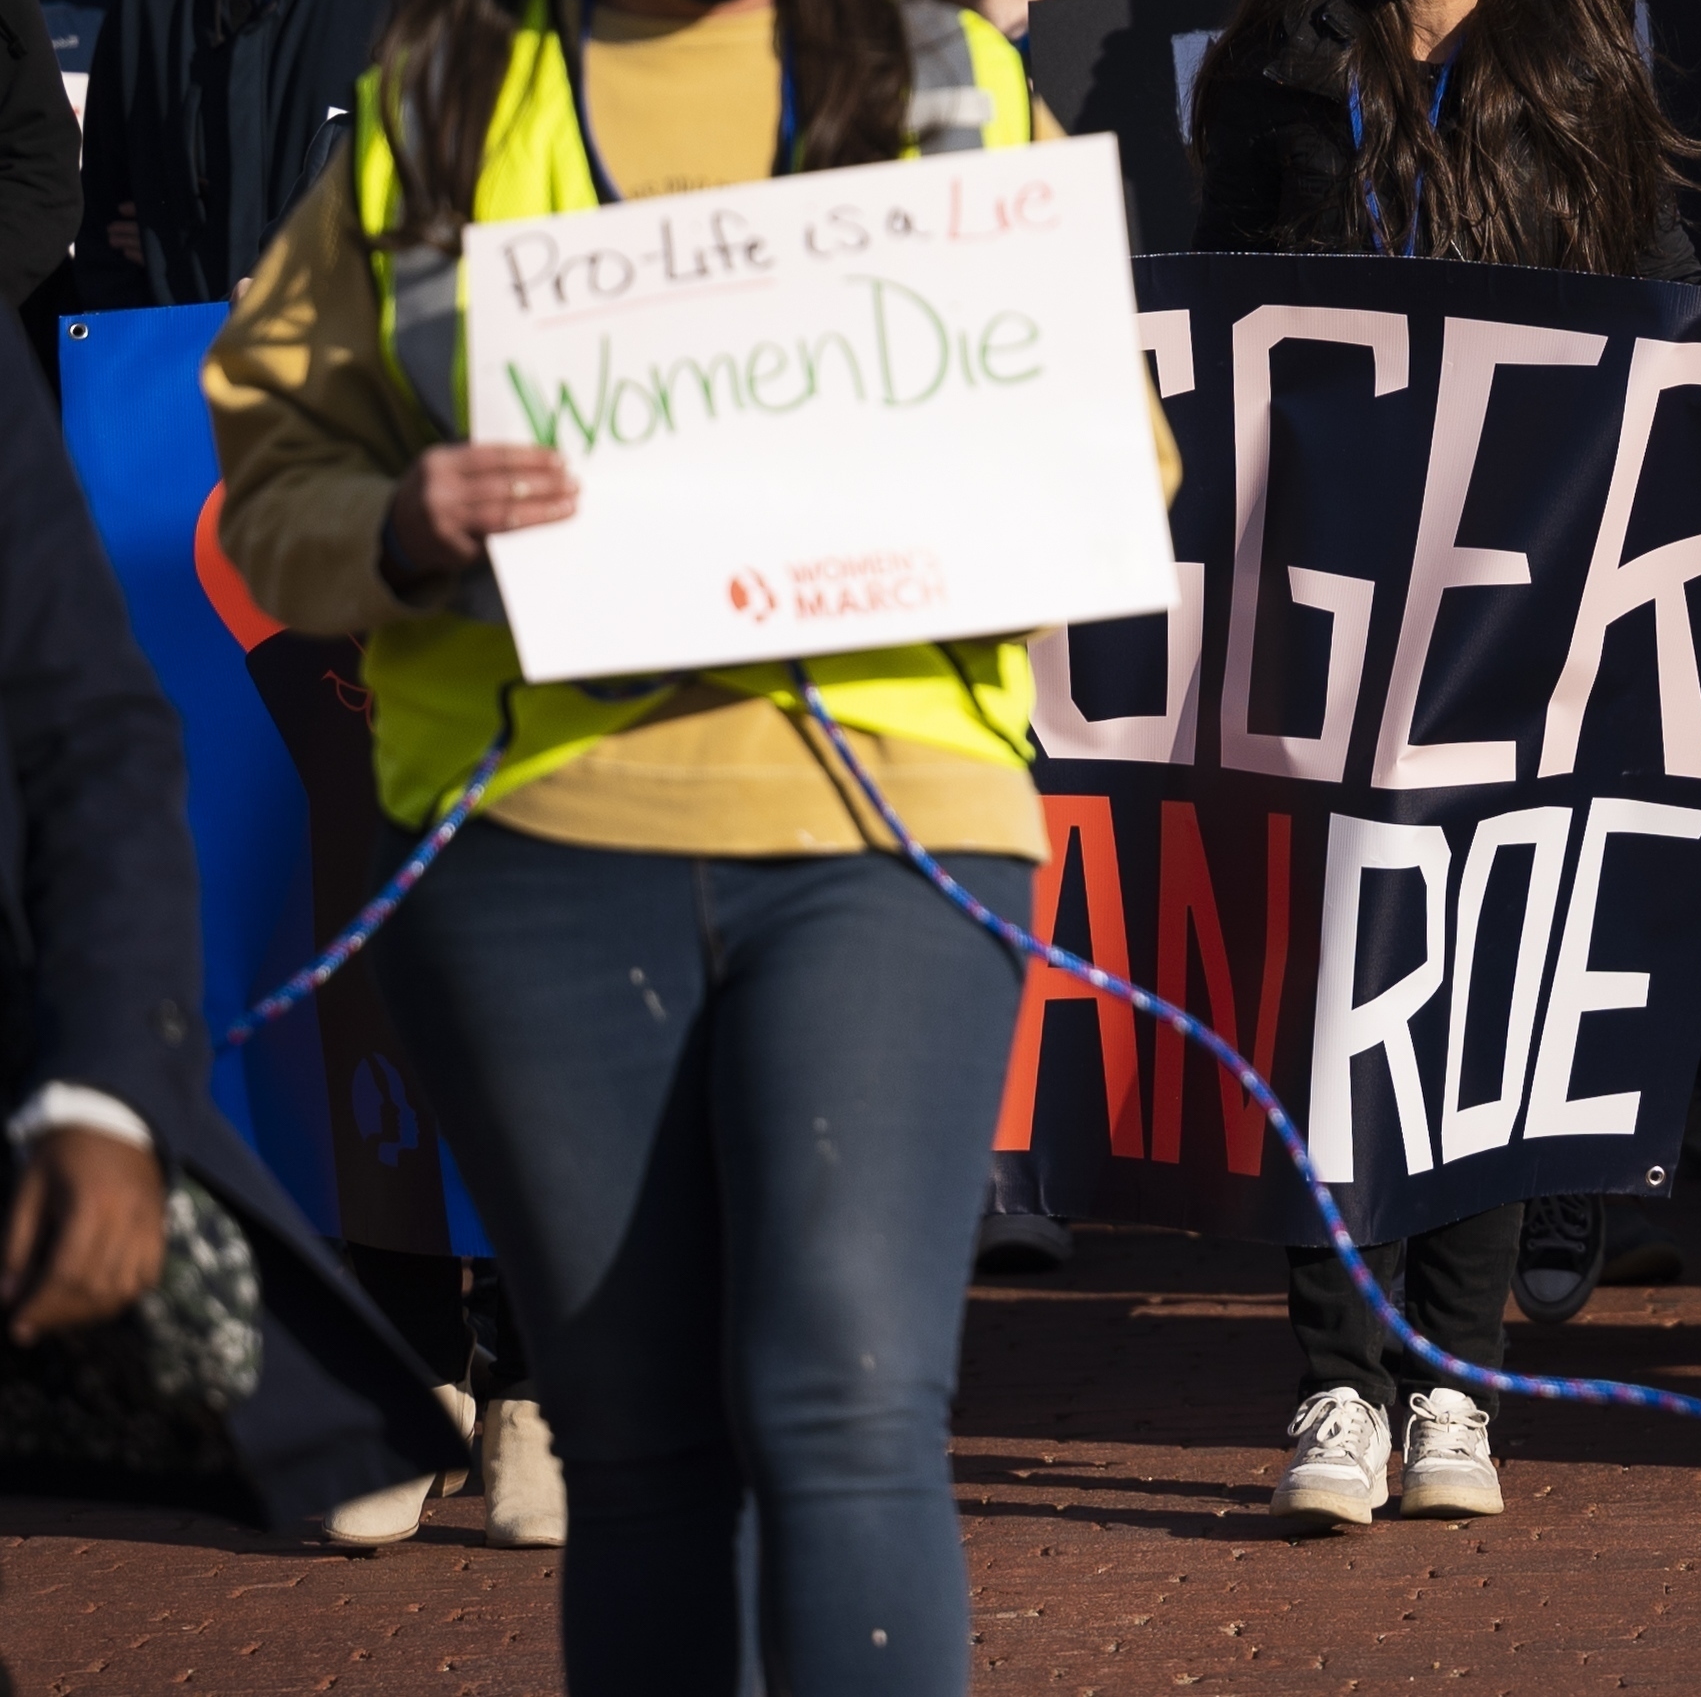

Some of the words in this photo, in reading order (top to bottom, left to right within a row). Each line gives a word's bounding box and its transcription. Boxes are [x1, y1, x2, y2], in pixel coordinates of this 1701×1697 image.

[500, 208, 778, 313] Pro-Life
[803, 206, 872, 256] is
[892, 215, 935, 243] a
[504, 333, 866, 457] Women
[844, 273, 1045, 407] Die
[793, 579, 949, 623] MARCH
[993, 794, 1293, 1178] AN
